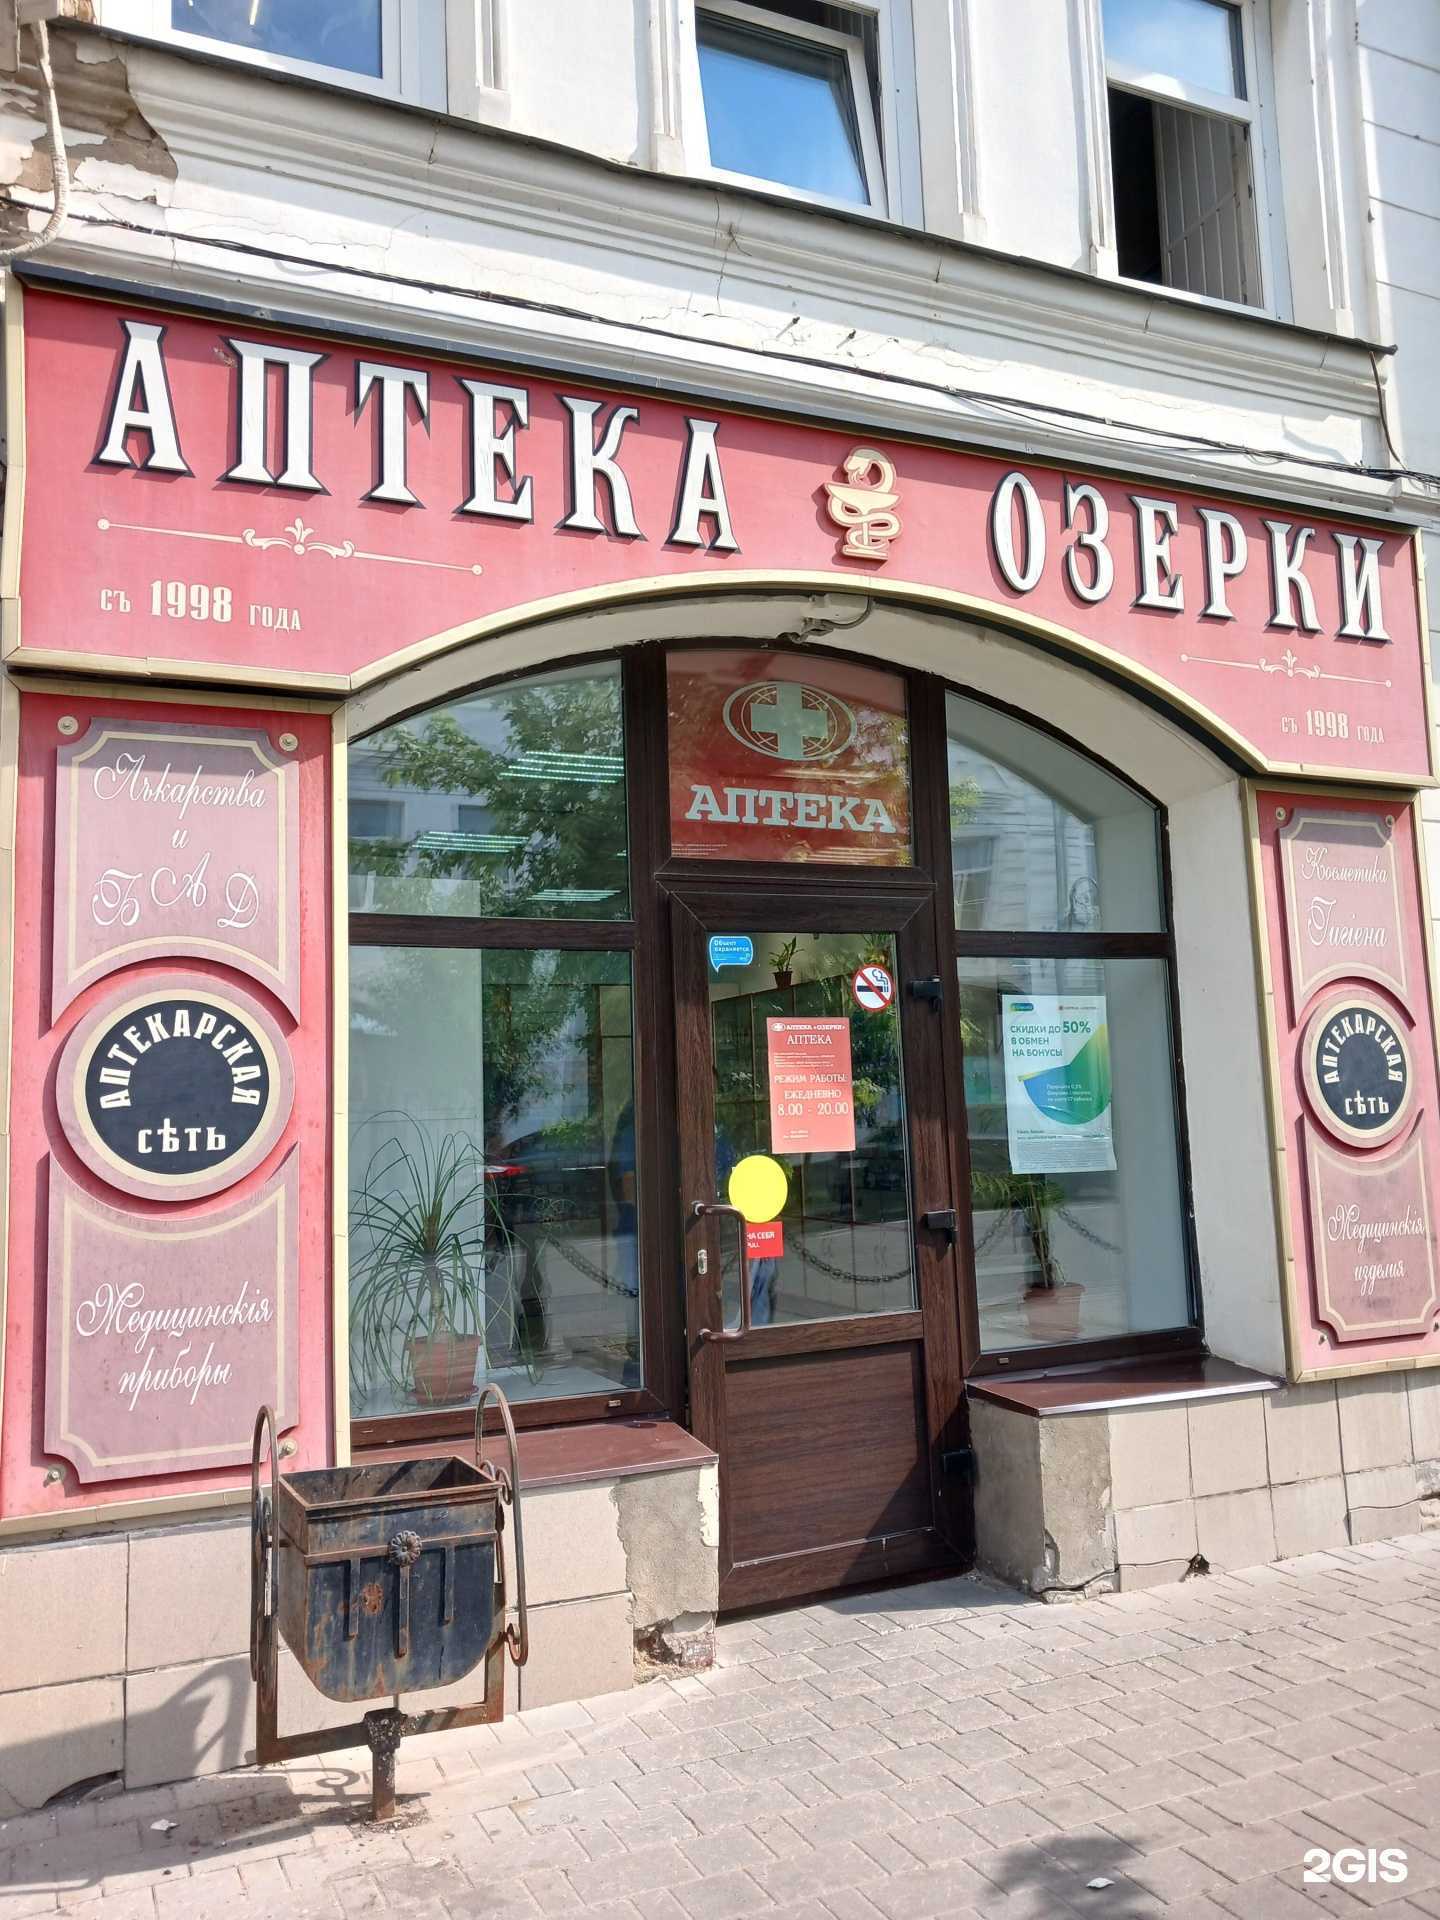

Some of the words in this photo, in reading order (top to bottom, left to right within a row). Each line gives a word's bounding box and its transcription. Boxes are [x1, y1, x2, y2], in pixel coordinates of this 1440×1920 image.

[86, 319, 742, 554] АПТЕКА
[991, 471, 1392, 644] ОЗЕРКИ
[149, 581, 233, 624] 1998
[1306, 709, 1349, 739] 1998
[684, 784, 896, 834] АПТЕКА
[171, 826, 190, 849] и
[1301, 846, 1390, 884] Косметика
[787, 1034, 832, 1045] АПТЕКА
[1010, 1025, 1046, 1034] СКИДКИ
[1048, 1025, 1061, 1034] ДО
[1063, 1020, 1091, 1034] 50%
[1011, 1037, 1017, 1045] В
[1019, 1036, 1049, 1045] ОБМЕН
[100, 1009, 261, 1111] АПТЕКАРСКАЯ
[1012, 1048, 1025, 1057] НА
[1027, 1048, 1063, 1057] БОНУСЫ
[1322, 1013, 1404, 1085] АПТЕКАРСКАЯ
[774, 1074, 807, 1083] РЕЖИМ
[777, 1103, 803, 1116] 8.00
[817, 1101, 849, 1115] 20.00
[784, 1089, 842, 1100] ЕЖЕДНЕВНО
[1354, 1259, 1406, 1297] изделия
[118, 1341, 233, 1411] приборы
